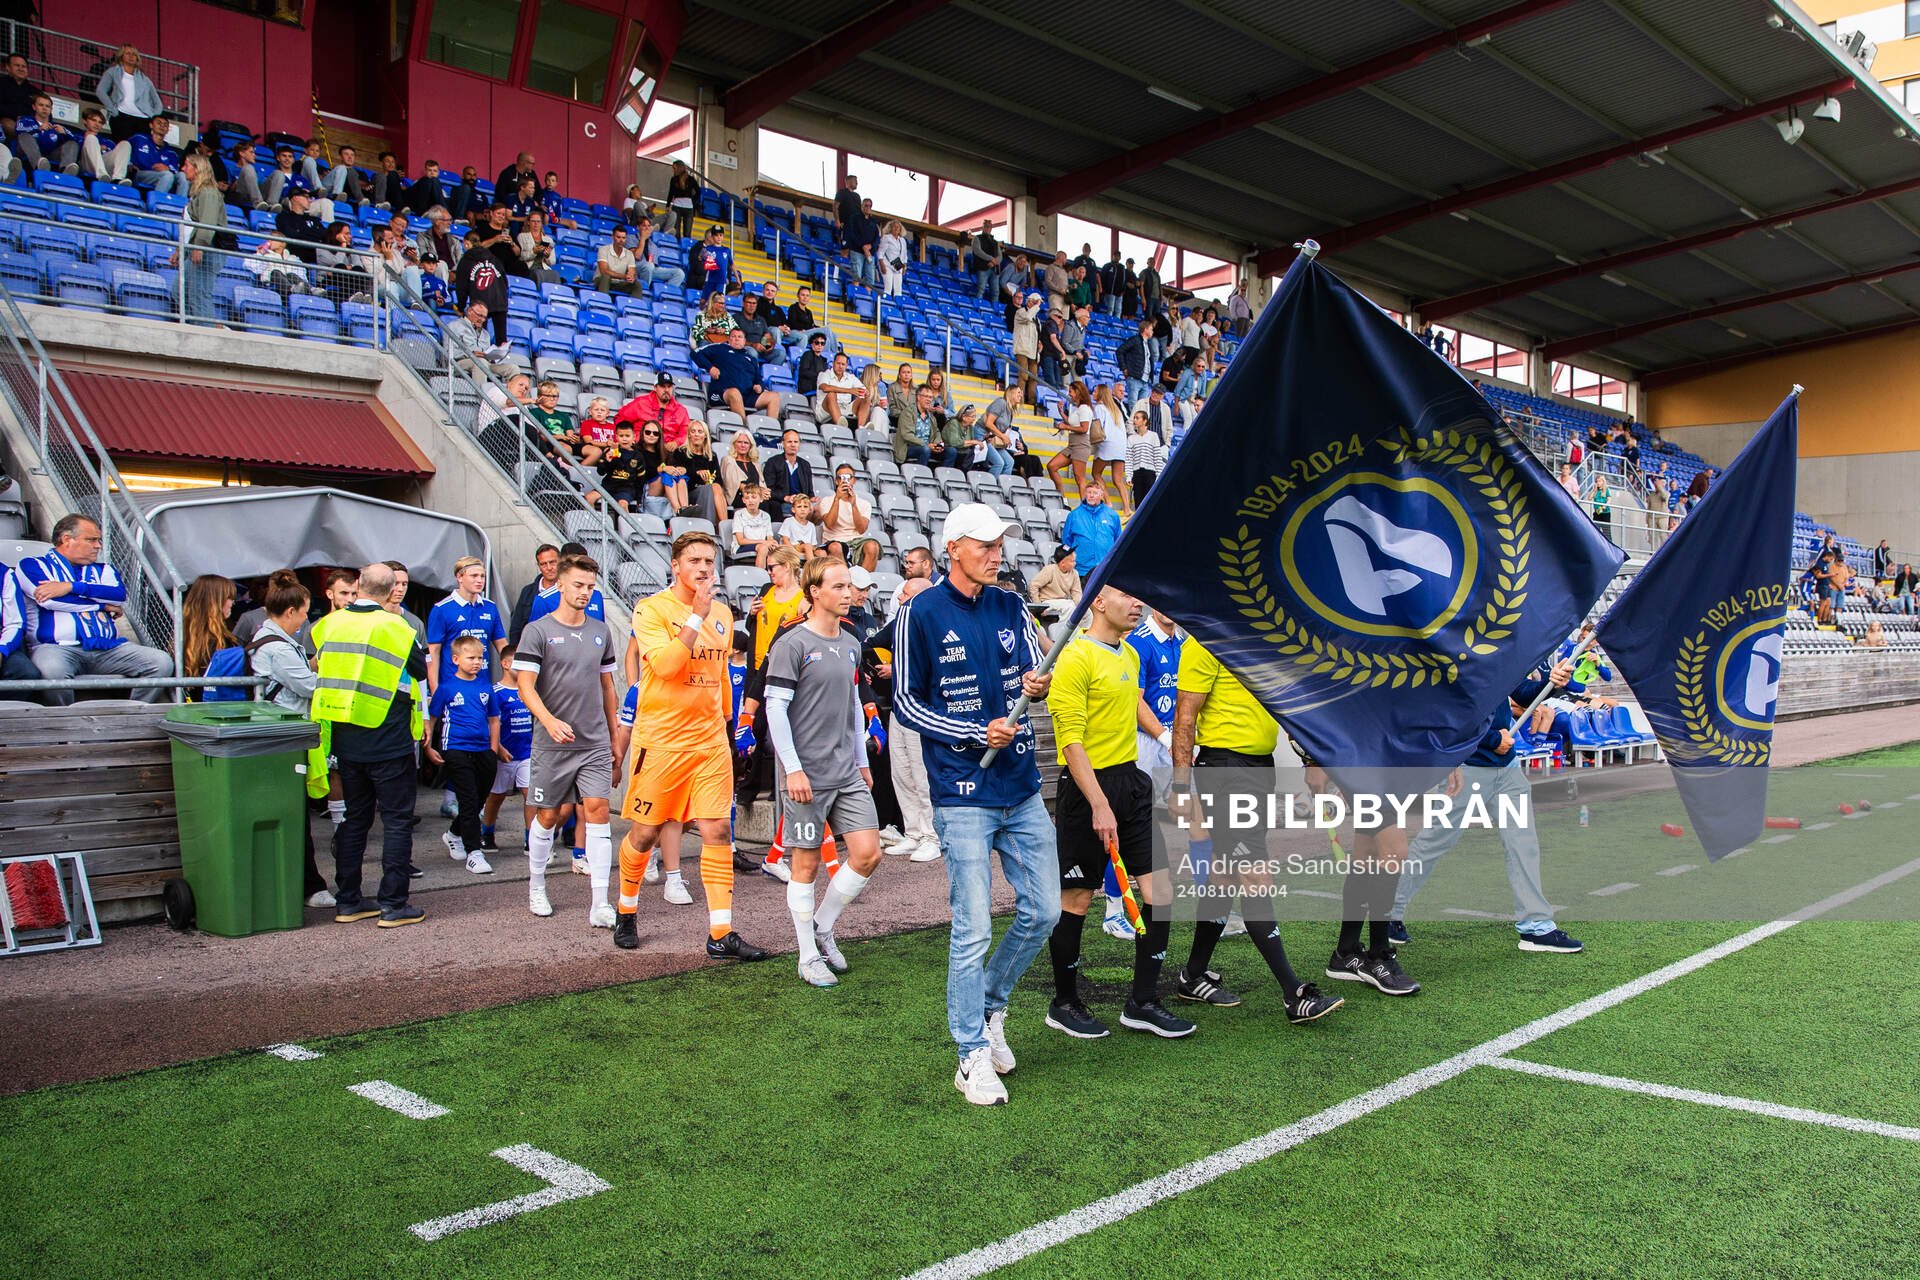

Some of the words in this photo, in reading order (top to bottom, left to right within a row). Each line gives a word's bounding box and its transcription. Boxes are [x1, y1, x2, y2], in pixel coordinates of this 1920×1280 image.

[584, 122, 597, 138] C
[727, 140, 736, 153] C
[1236, 433, 1365, 519] 1924-2024
[690, 645, 728, 661] LÄTT
[946, 646, 966, 655] TEAM
[939, 653, 967, 664] SPORTIA
[947, 703, 983, 713] PROJEKT
[535, 787, 544, 802] 5
[956, 781, 976, 795] TP
[634, 797, 653, 815] 27
[795, 822, 816, 840] 10
